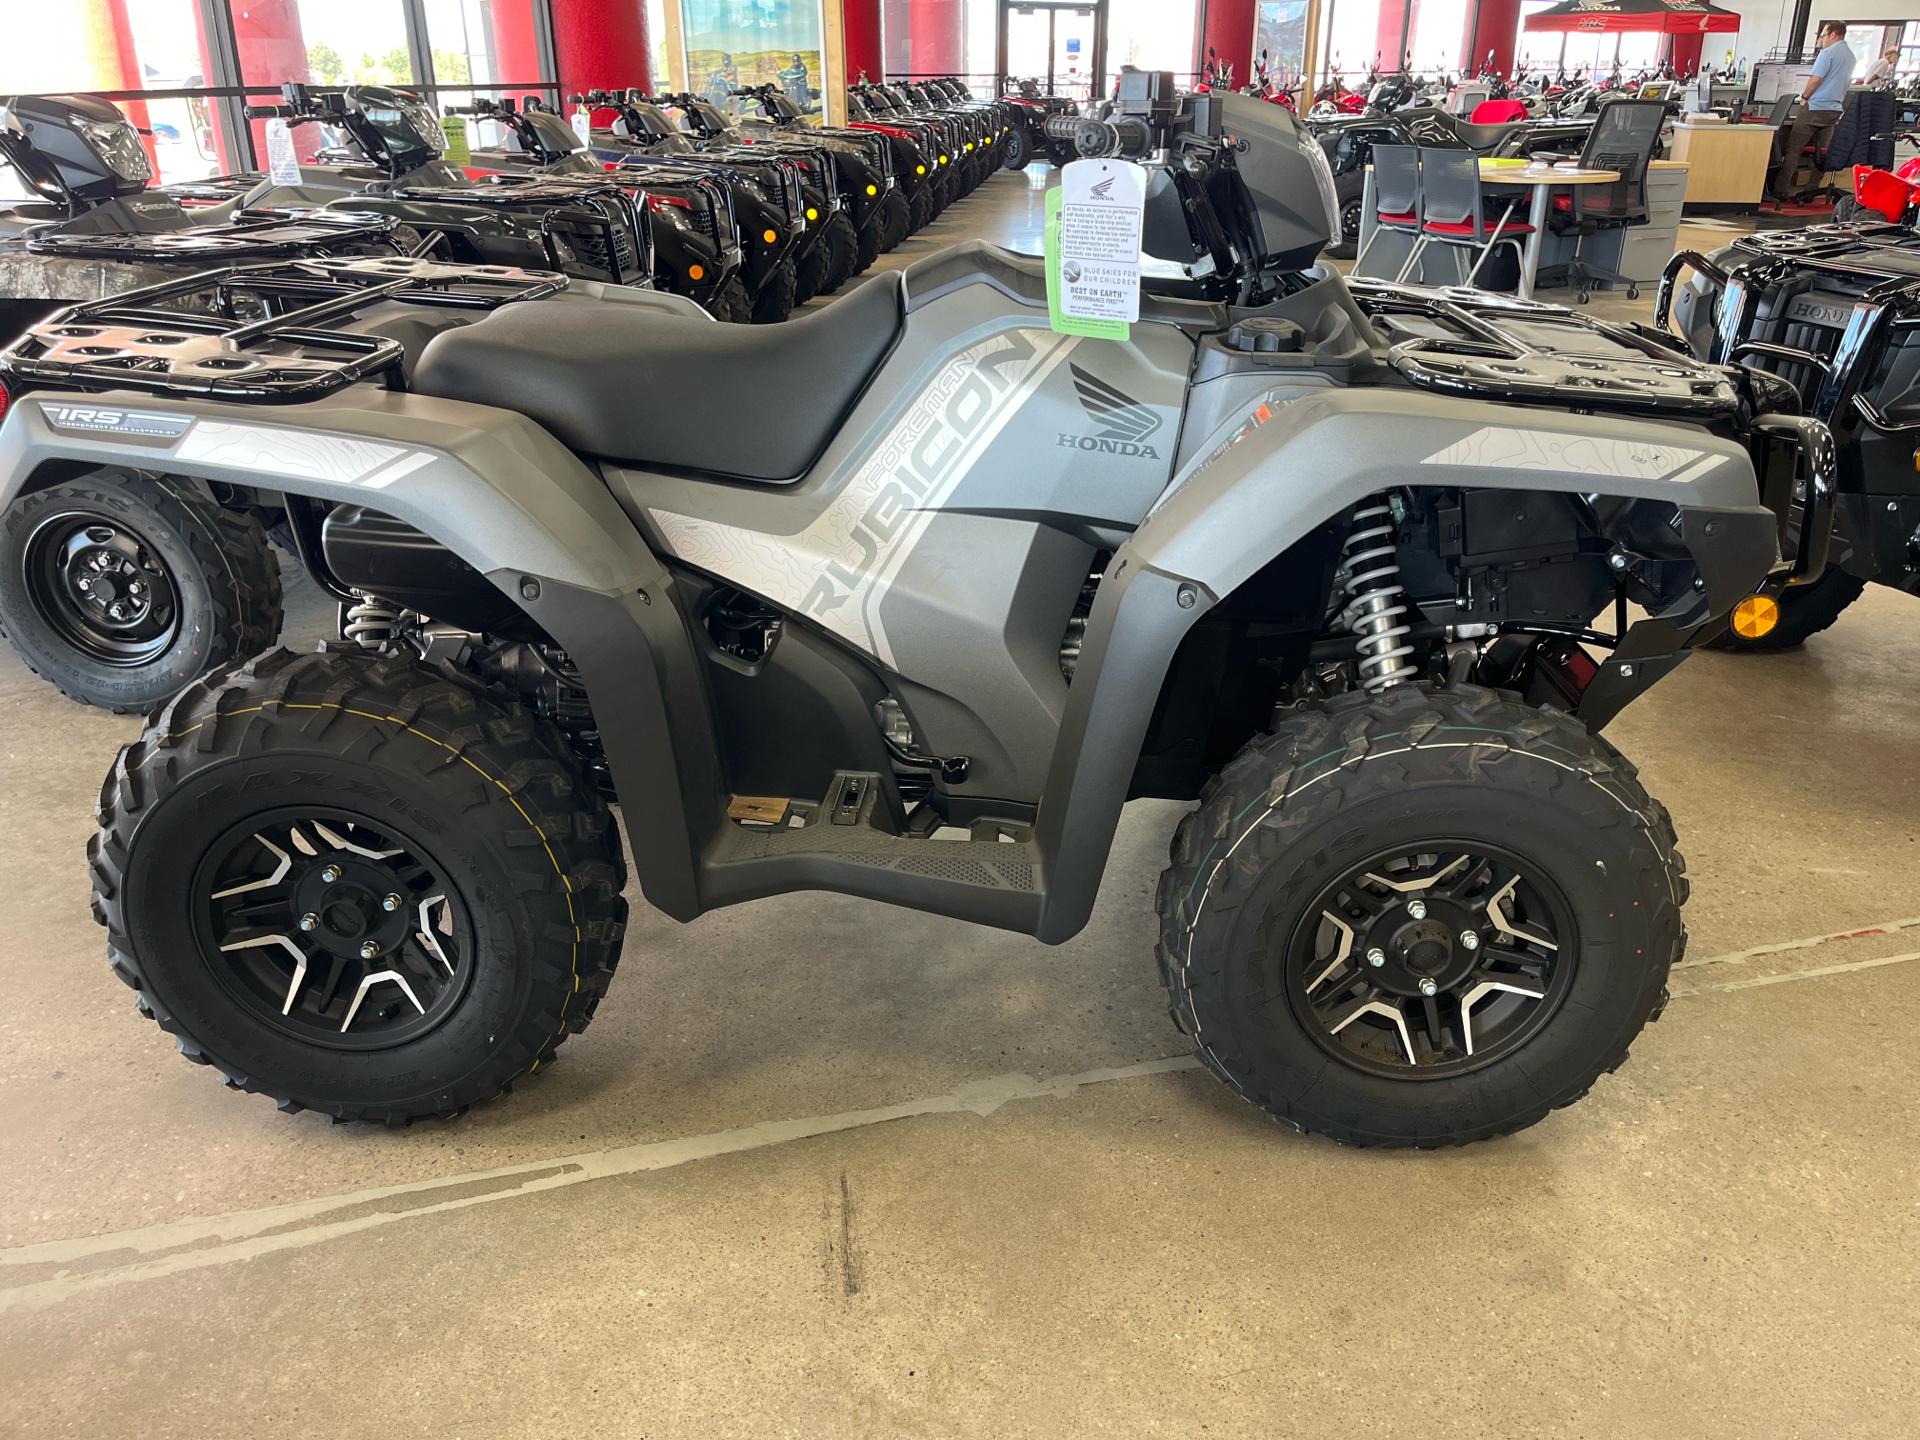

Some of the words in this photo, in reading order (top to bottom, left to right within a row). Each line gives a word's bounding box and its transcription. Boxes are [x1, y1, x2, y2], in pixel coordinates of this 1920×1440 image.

[1100, 277, 1136, 285] CHILDREN
[1072, 295, 1104, 303] PERFORMANCE
[58, 408, 123, 424] IRS
[865, 352, 976, 490] FOREMAN
[341, 441, 356, 454] 6800
[1056, 433, 1160, 460] HONDA
[1630, 454, 1647, 465] 6387
[798, 329, 1037, 618] RUBICON
[6, 486, 130, 536] MAXXIS
[196, 770, 446, 836] MAXXIS
[1245, 826, 1370, 1031] MAXXIS
